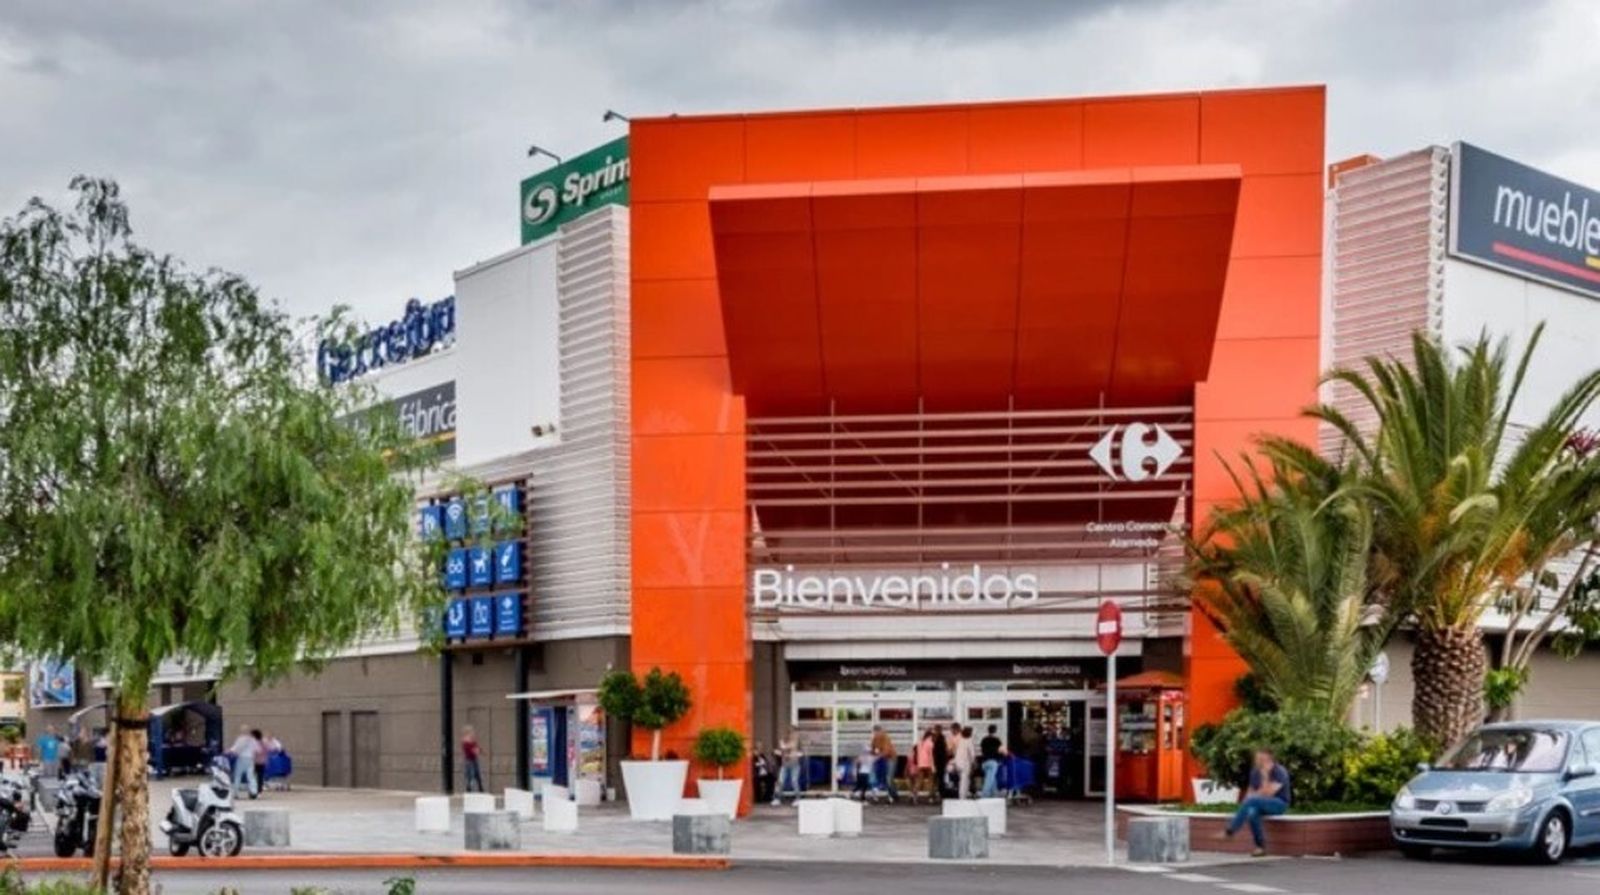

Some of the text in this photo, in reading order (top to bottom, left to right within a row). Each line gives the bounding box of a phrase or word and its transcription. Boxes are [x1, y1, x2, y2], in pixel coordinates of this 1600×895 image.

[1086, 521, 1125, 532] Centro
[1109, 537, 1159, 548] Alameda
[753, 562, 1039, 608] Bienvenidos
[840, 665, 907, 676] bienvenidos
[1013, 664, 1081, 675] bienvenidos
